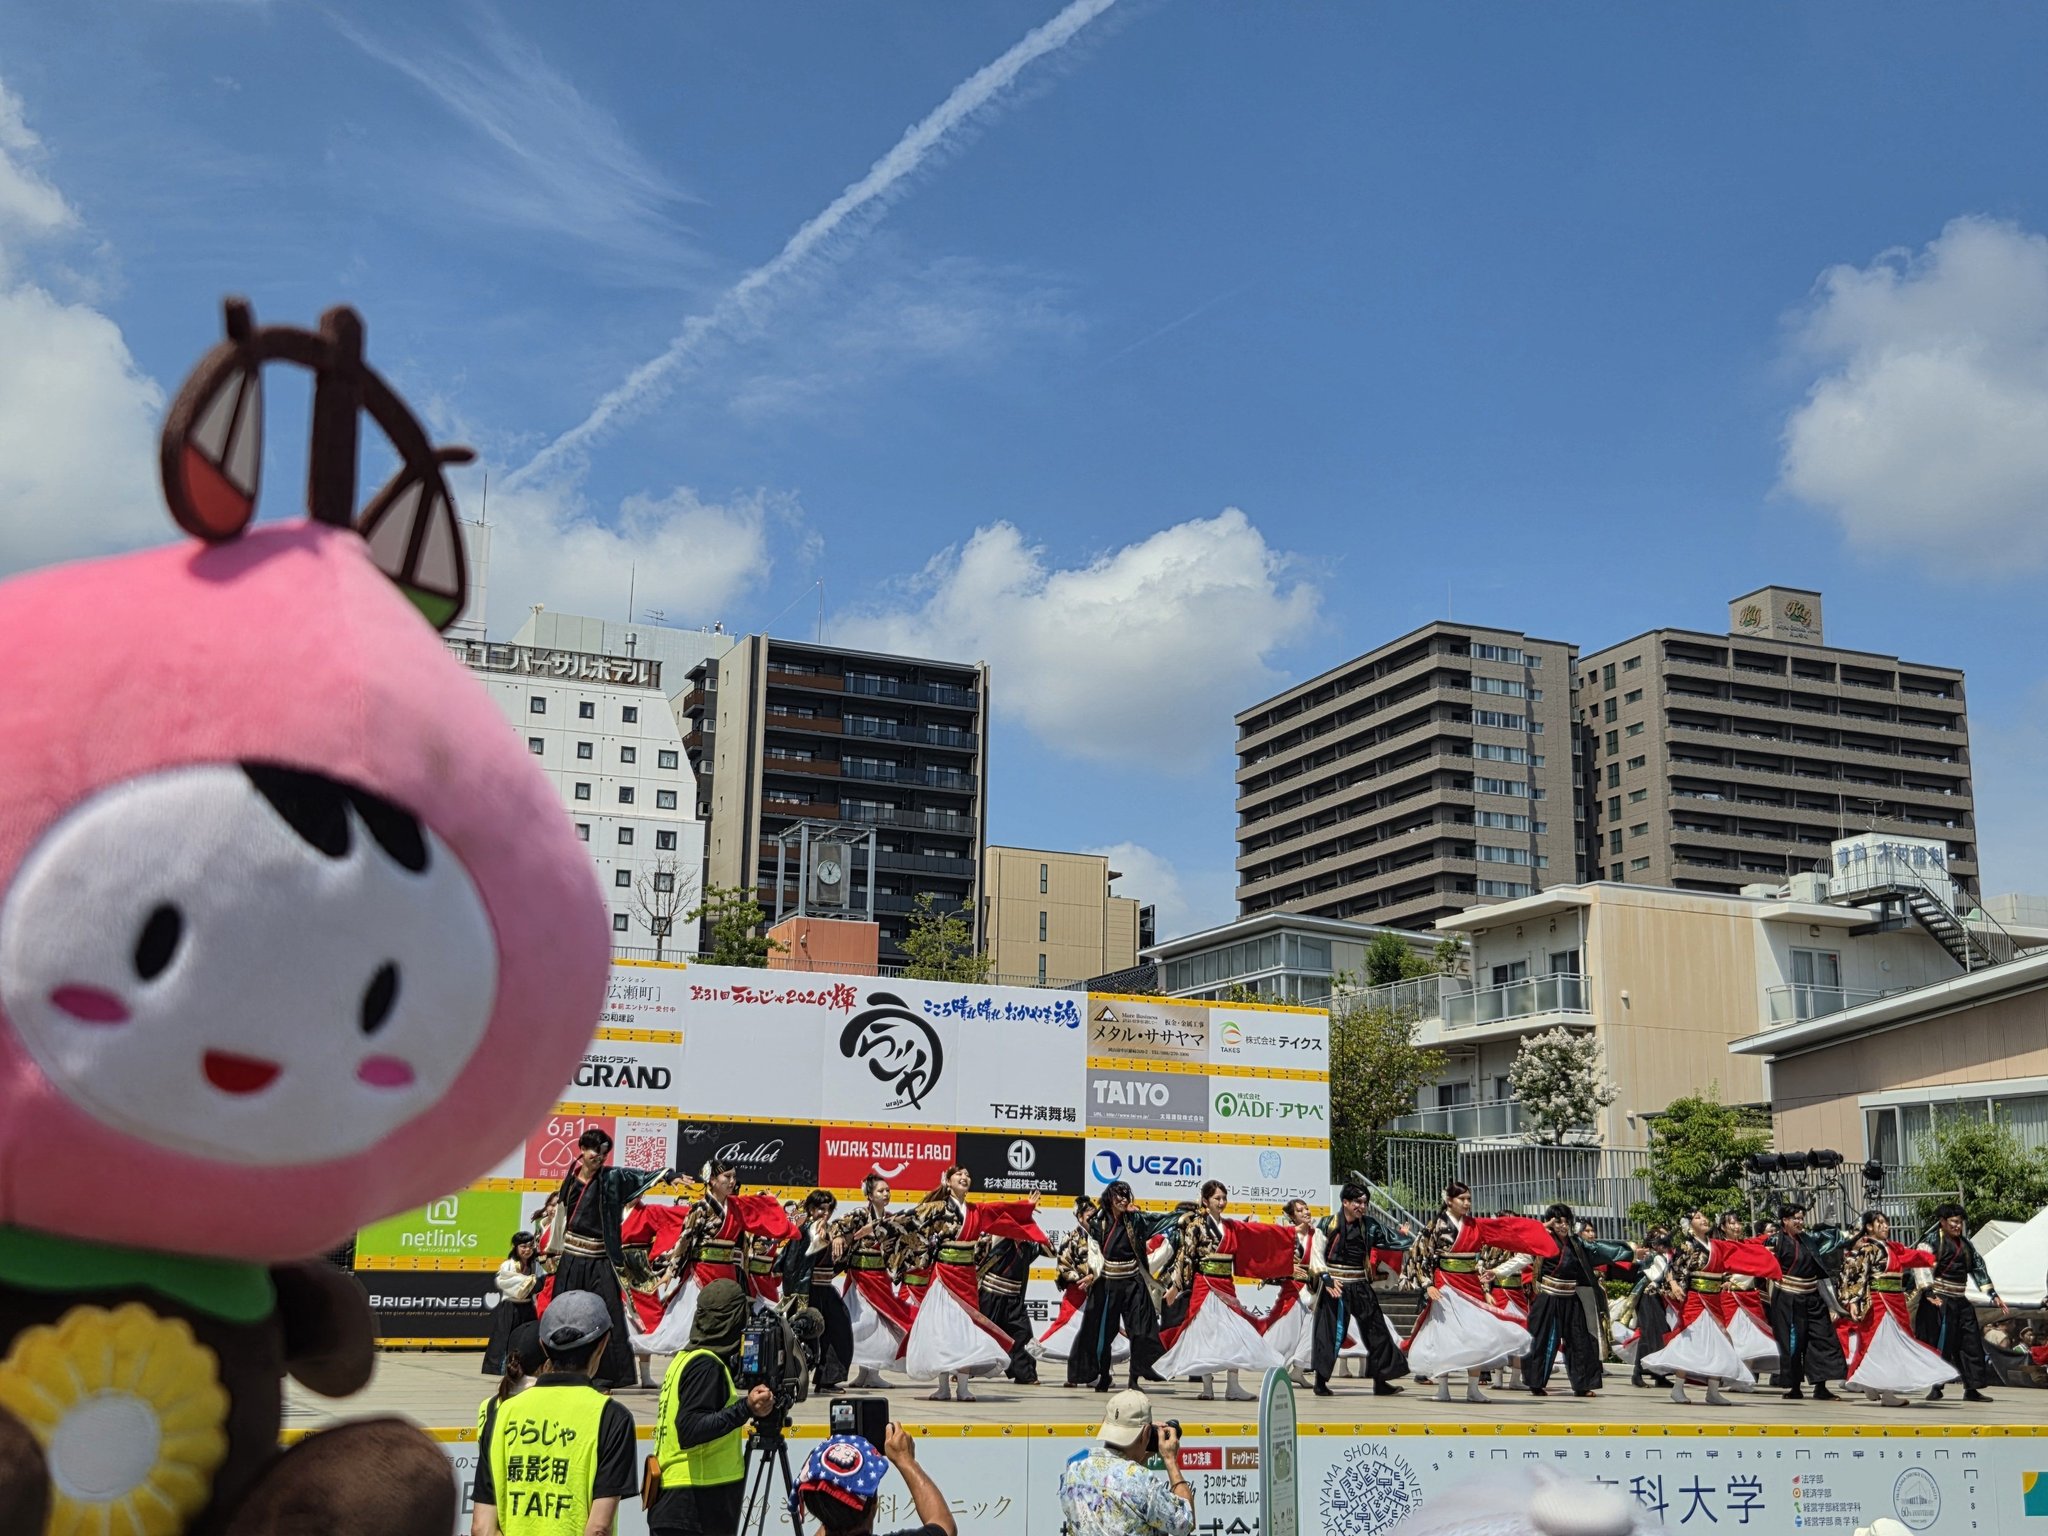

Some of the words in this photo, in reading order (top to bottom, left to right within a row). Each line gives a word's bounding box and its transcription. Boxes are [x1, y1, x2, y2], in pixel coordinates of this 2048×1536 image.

[1093, 1025, 1205, 1047] メタル・ササヤマ
[1245, 1036, 1277, 1046] 株式会社
[1278, 1036, 1323, 1051] テイクス
[1220, 1046, 1241, 1054] TAKES
[573, 1063, 672, 1090] GRAND
[1092, 1079, 1170, 1107] TAIYO
[1237, 1092, 1260, 1100] 株式会社
[885, 1099, 904, 1108] uraja
[989, 1103, 1077, 1123] 下石井演舞場
[714, 1138, 785, 1163] Bullet
[825, 1139, 869, 1158] WORK
[871, 1141, 914, 1160] SMILE
[916, 1143, 952, 1161] LABO
[983, 1177, 1058, 1191] 杉本道路株式会社
[401, 1229, 479, 1248] netlinks
[503, 1419, 577, 1448] うらじゃ
[1181, 1451, 1212, 1466] セルフ洗車
[1203, 1473, 1248, 1490] 3つのサービスが
[1343, 1442, 1388, 1463] SHOKA
[1394, 1454, 1424, 1513] UNIVER
[1801, 1473, 1825, 1485] 法学部
[1588, 1473, 1766, 1526] 科大学
[1802, 1487, 1833, 1499] 経済学部
[1803, 1502, 1862, 1514] 経営学部経営学科
